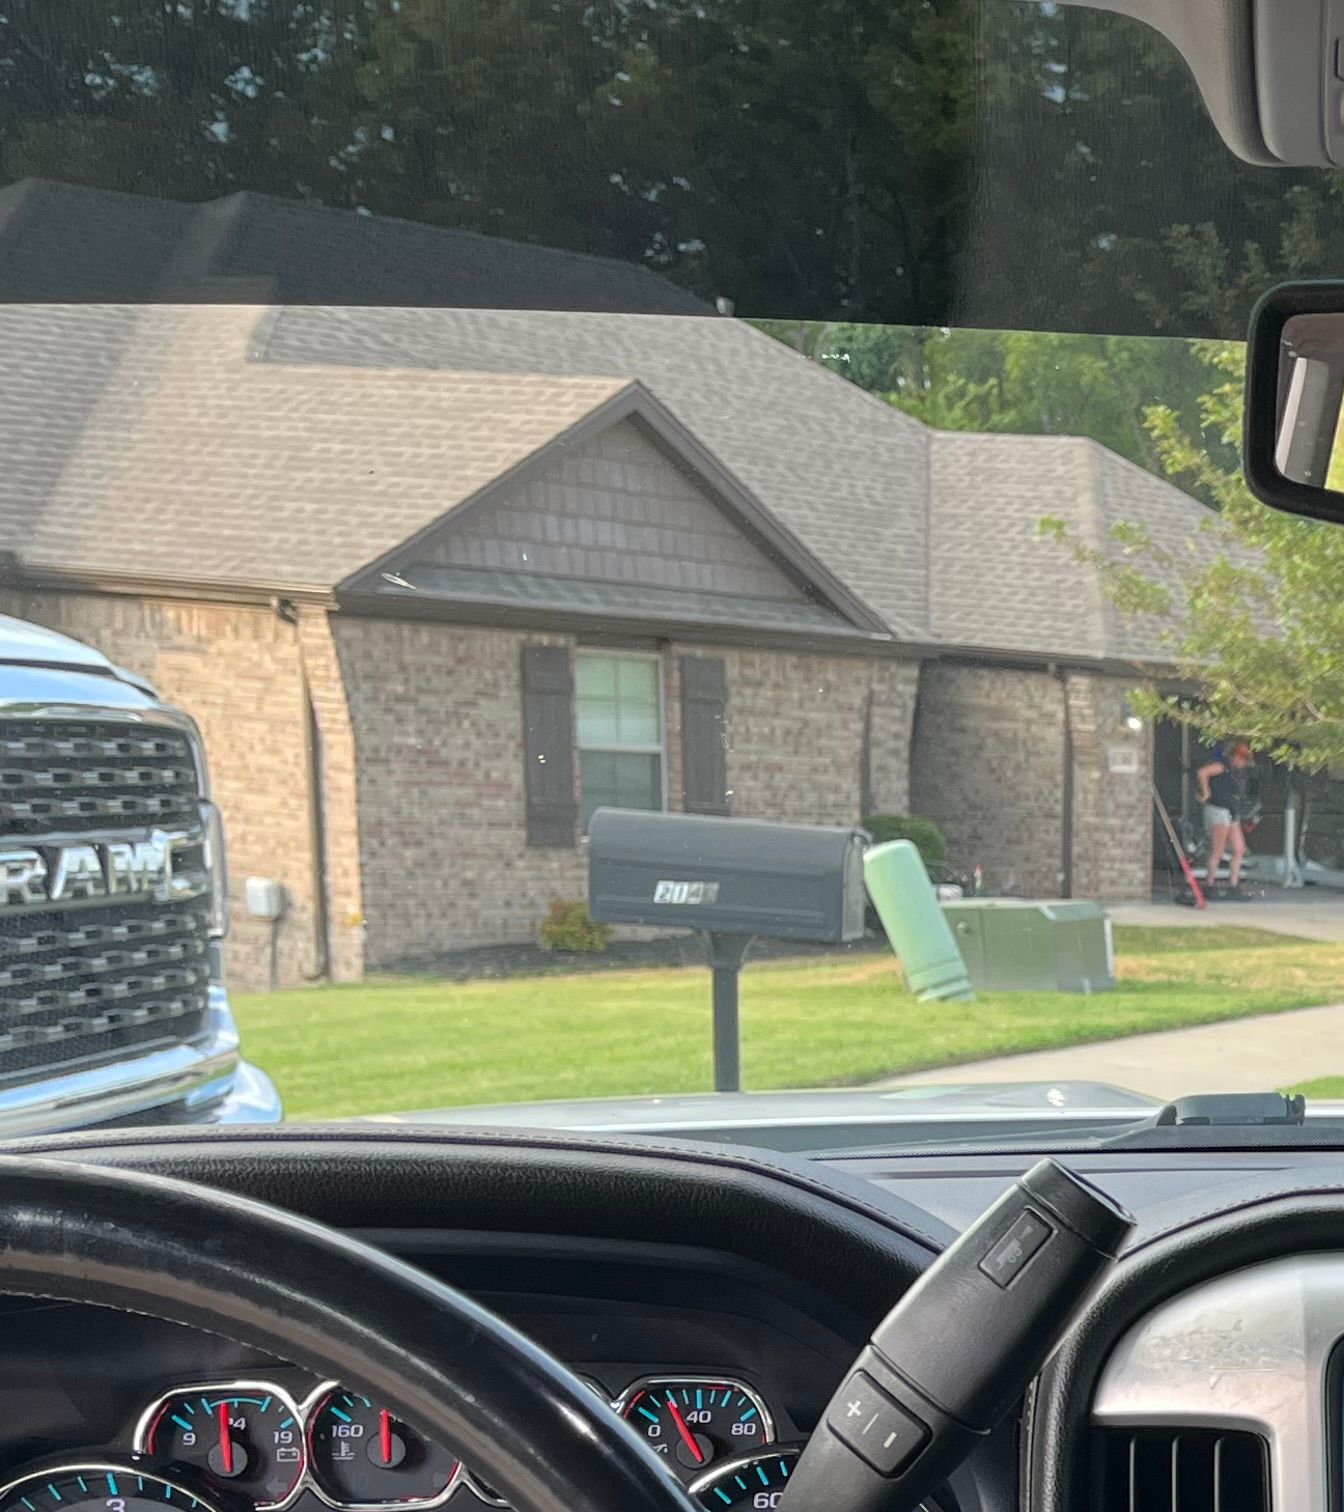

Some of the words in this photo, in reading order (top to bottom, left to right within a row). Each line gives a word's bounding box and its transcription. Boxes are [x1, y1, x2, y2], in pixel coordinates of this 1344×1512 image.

[0, 843, 163, 902] RAM
[686, 1411, 712, 1424] 40
[331, 1423, 364, 1439] 160
[648, 1424, 661, 1438] 0
[731, 1422, 756, 1436] 80
[182, 1432, 196, 1447] 9
[273, 1430, 293, 1445] 19
